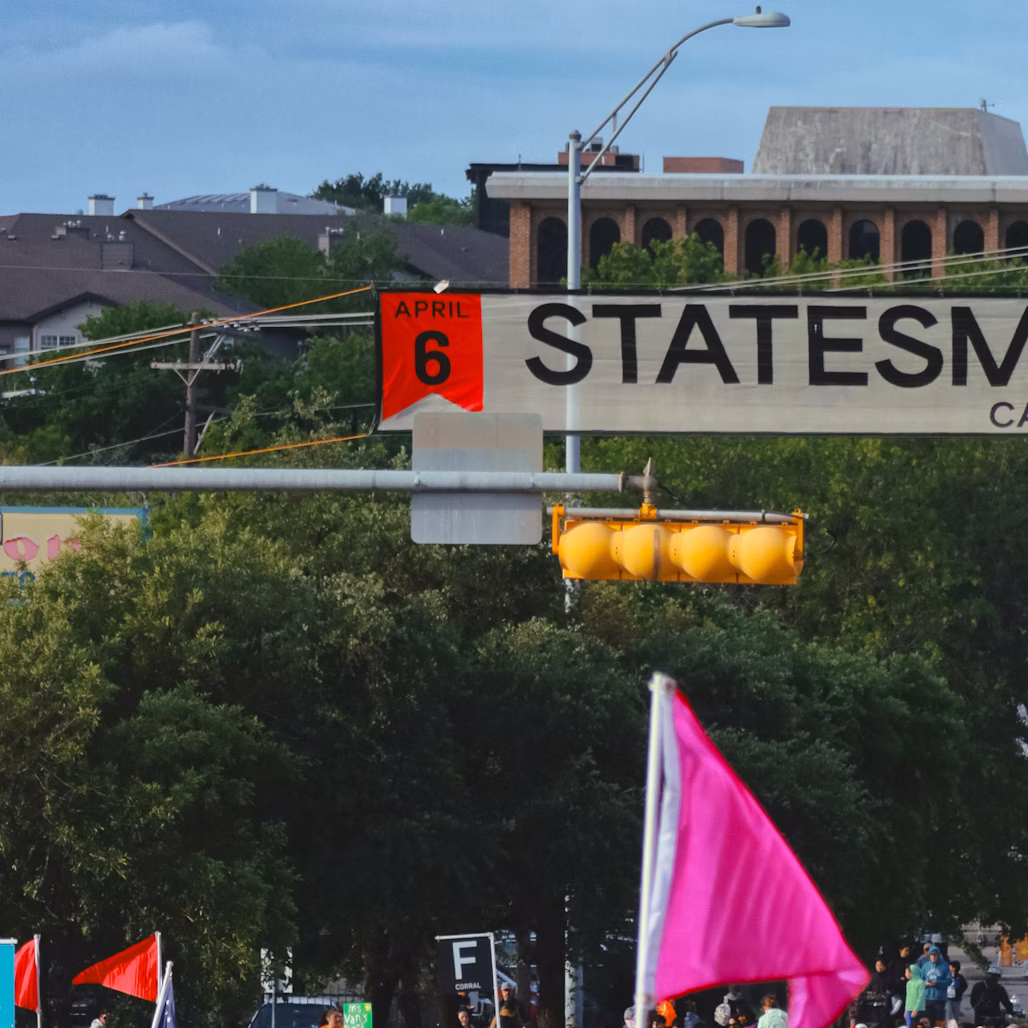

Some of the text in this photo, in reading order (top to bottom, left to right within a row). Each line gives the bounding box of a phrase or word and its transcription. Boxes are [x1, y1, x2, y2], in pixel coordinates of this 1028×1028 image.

[394, 300, 471, 320] APRIL
[413, 330, 452, 386] 6
[452, 940, 478, 981] F
[454, 982, 482, 991] CORRAL
